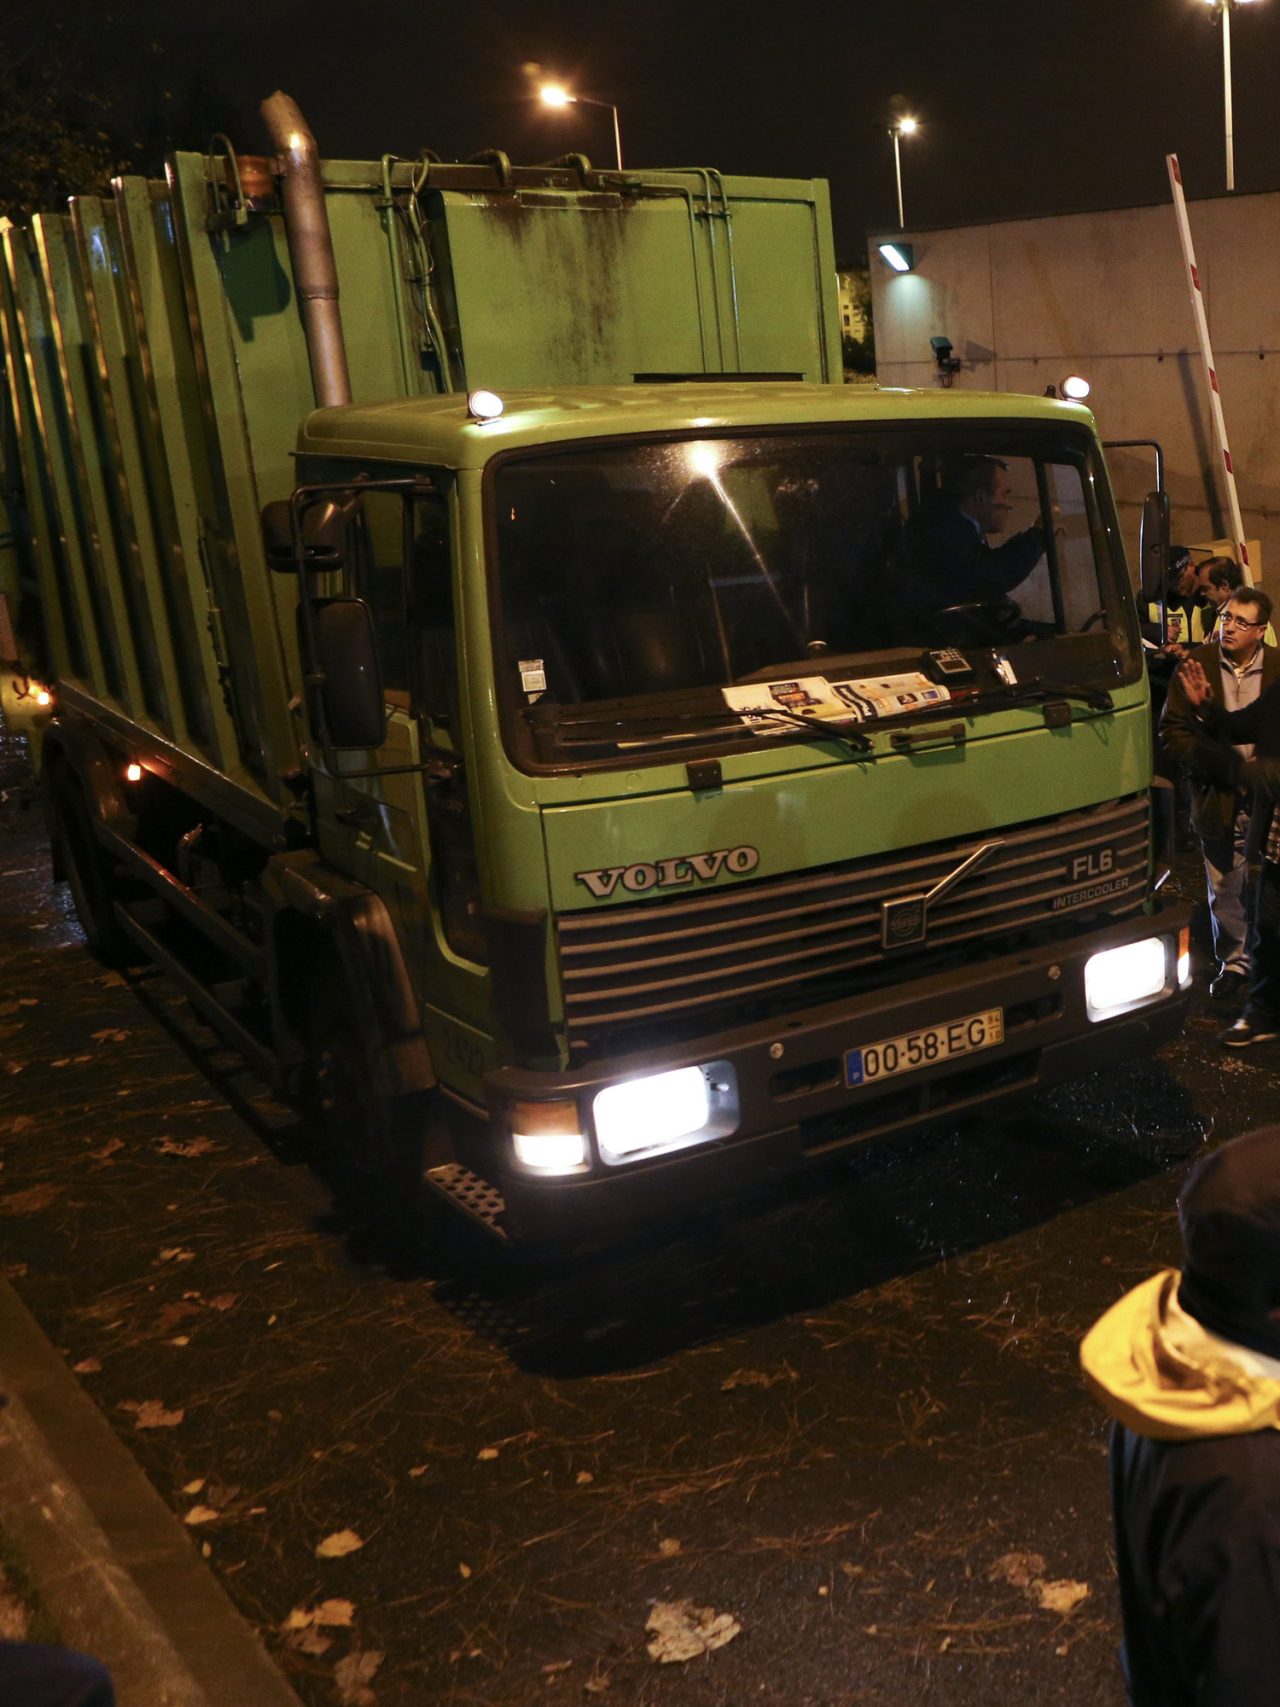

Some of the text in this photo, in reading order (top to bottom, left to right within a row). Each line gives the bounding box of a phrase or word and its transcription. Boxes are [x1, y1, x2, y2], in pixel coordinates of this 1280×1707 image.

[575, 845, 760, 899] VOLVO
[1073, 849, 1112, 880] FL6
[1053, 877, 1129, 909] INTERCOOLER
